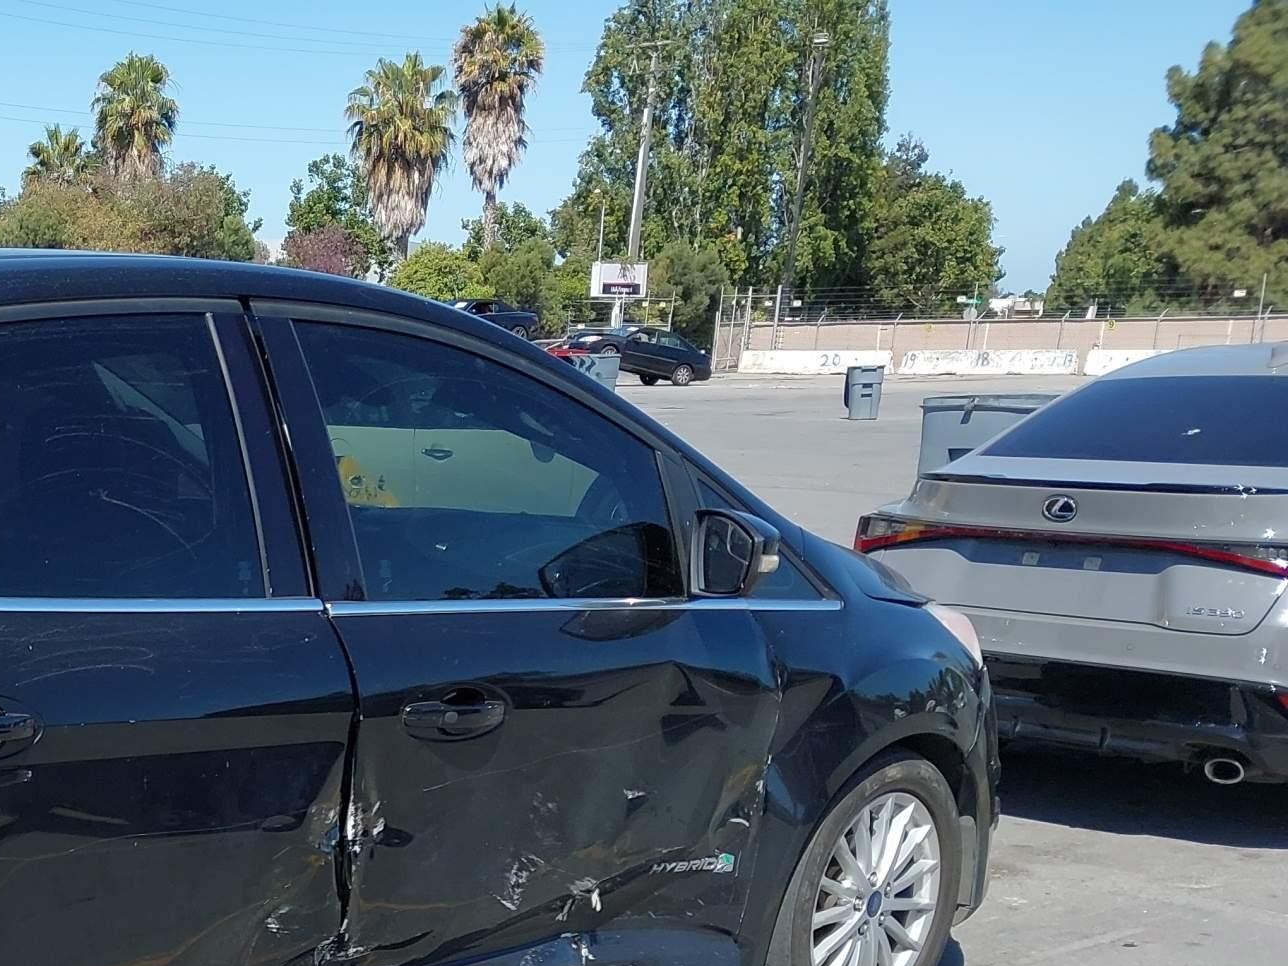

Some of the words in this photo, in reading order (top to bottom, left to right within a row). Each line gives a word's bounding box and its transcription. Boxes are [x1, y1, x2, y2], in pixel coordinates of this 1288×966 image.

[820, 353, 841, 367] 20
[903, 351, 917, 368] 19
[975, 351, 990, 367] 18
[649, 857, 718, 874] HYBRID
